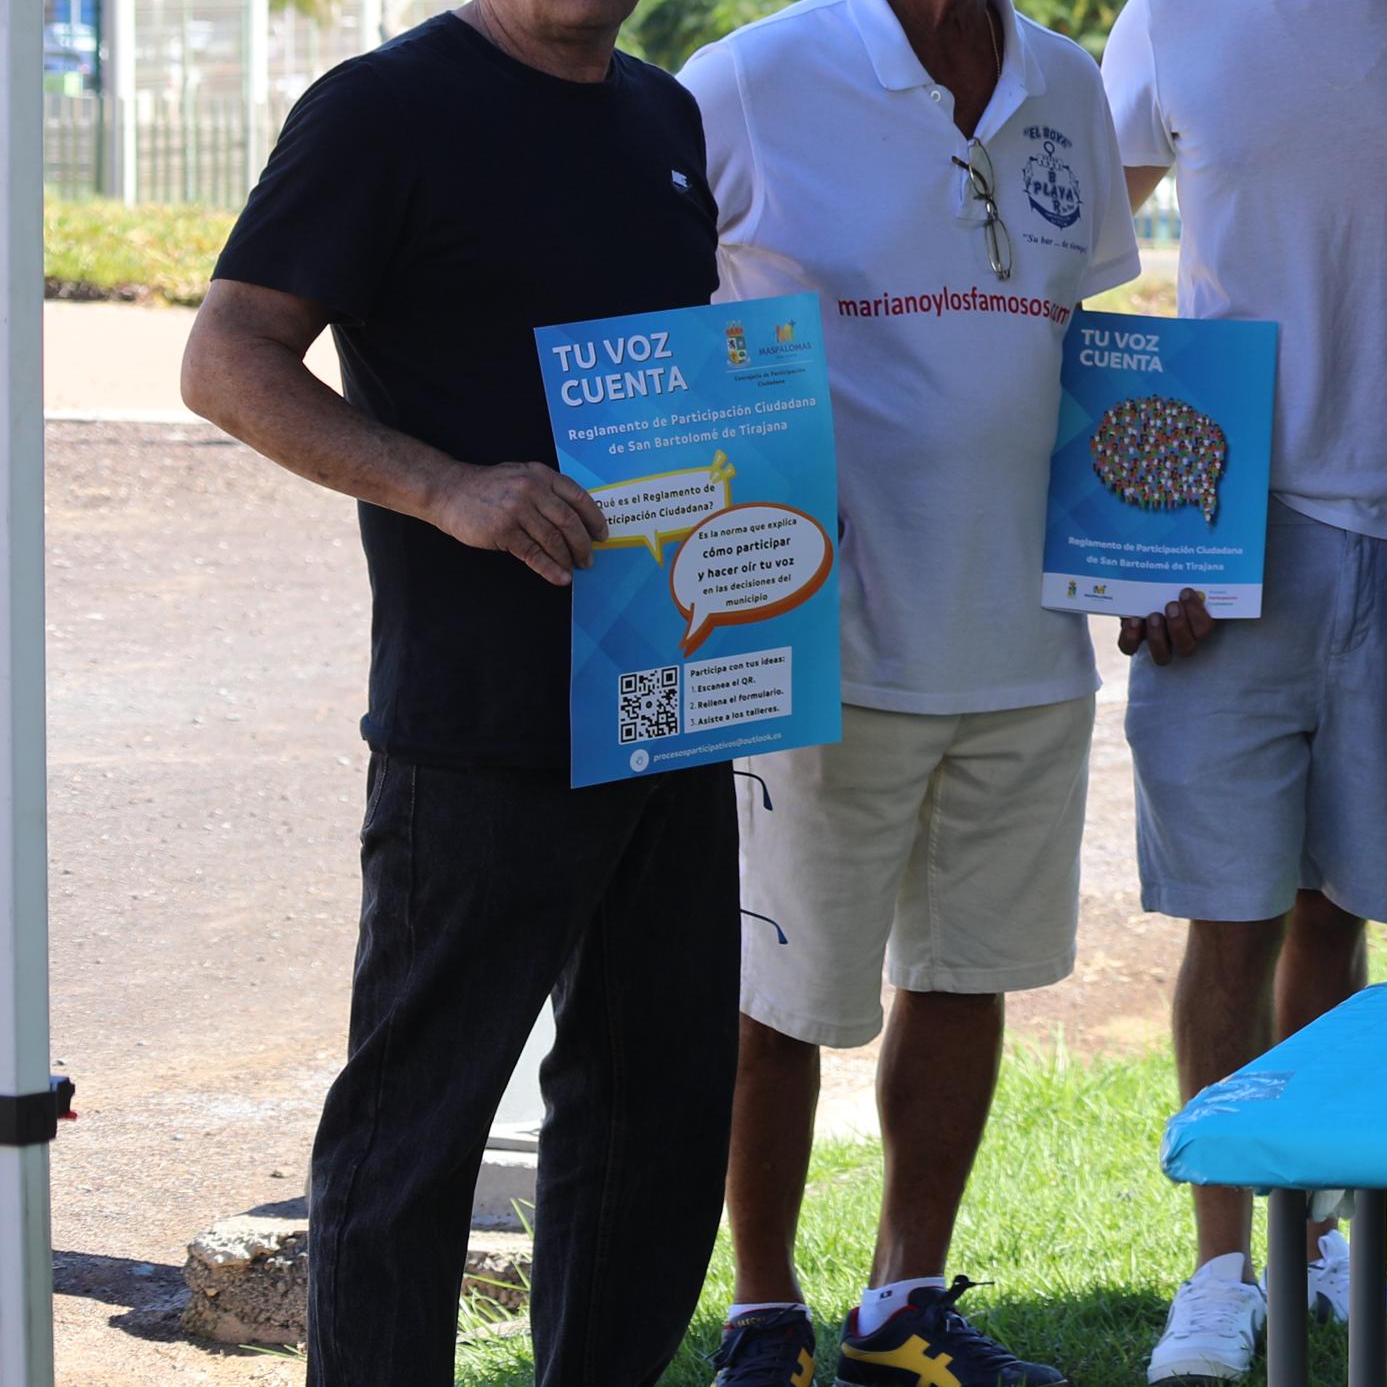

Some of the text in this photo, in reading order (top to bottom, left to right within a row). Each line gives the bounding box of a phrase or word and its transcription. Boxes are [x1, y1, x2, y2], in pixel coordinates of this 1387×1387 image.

[1081, 329, 1160, 352] TU VOZ
[553, 332, 672, 372] TU VOZ
[1080, 349, 1163, 373] CUENTA
[561, 366, 689, 407] CUENTA
[568, 396, 817, 442] Reglamento de Participación Ciudadana
[608, 420, 788, 455] de San Bartolomé de Tirajana
[595, 483, 716, 509] Qué es el Reglamento de
[659, 501, 715, 518] Ciudadana?
[699, 518, 798, 540] Es la norma que explica
[702, 536, 792, 559] cómo participar
[1068, 536, 1243, 556] Reglamento de Participación Ciudadana
[698, 556, 795, 582] y hacer oír tu voz
[1086, 555, 1224, 572] de San Bartolomé de Tirajana
[702, 574, 792, 595] en las decisiones del
[725, 592, 768, 607] municipio
[690, 656, 785, 678] Participa con tus ideas:
[697, 681, 730, 693] Escanea
[732, 679, 740, 687] el
[697, 697, 727, 710] Rellena
[729, 695, 737, 704] el
[697, 714, 724, 726] Asiste
[732, 710, 744, 720] los
